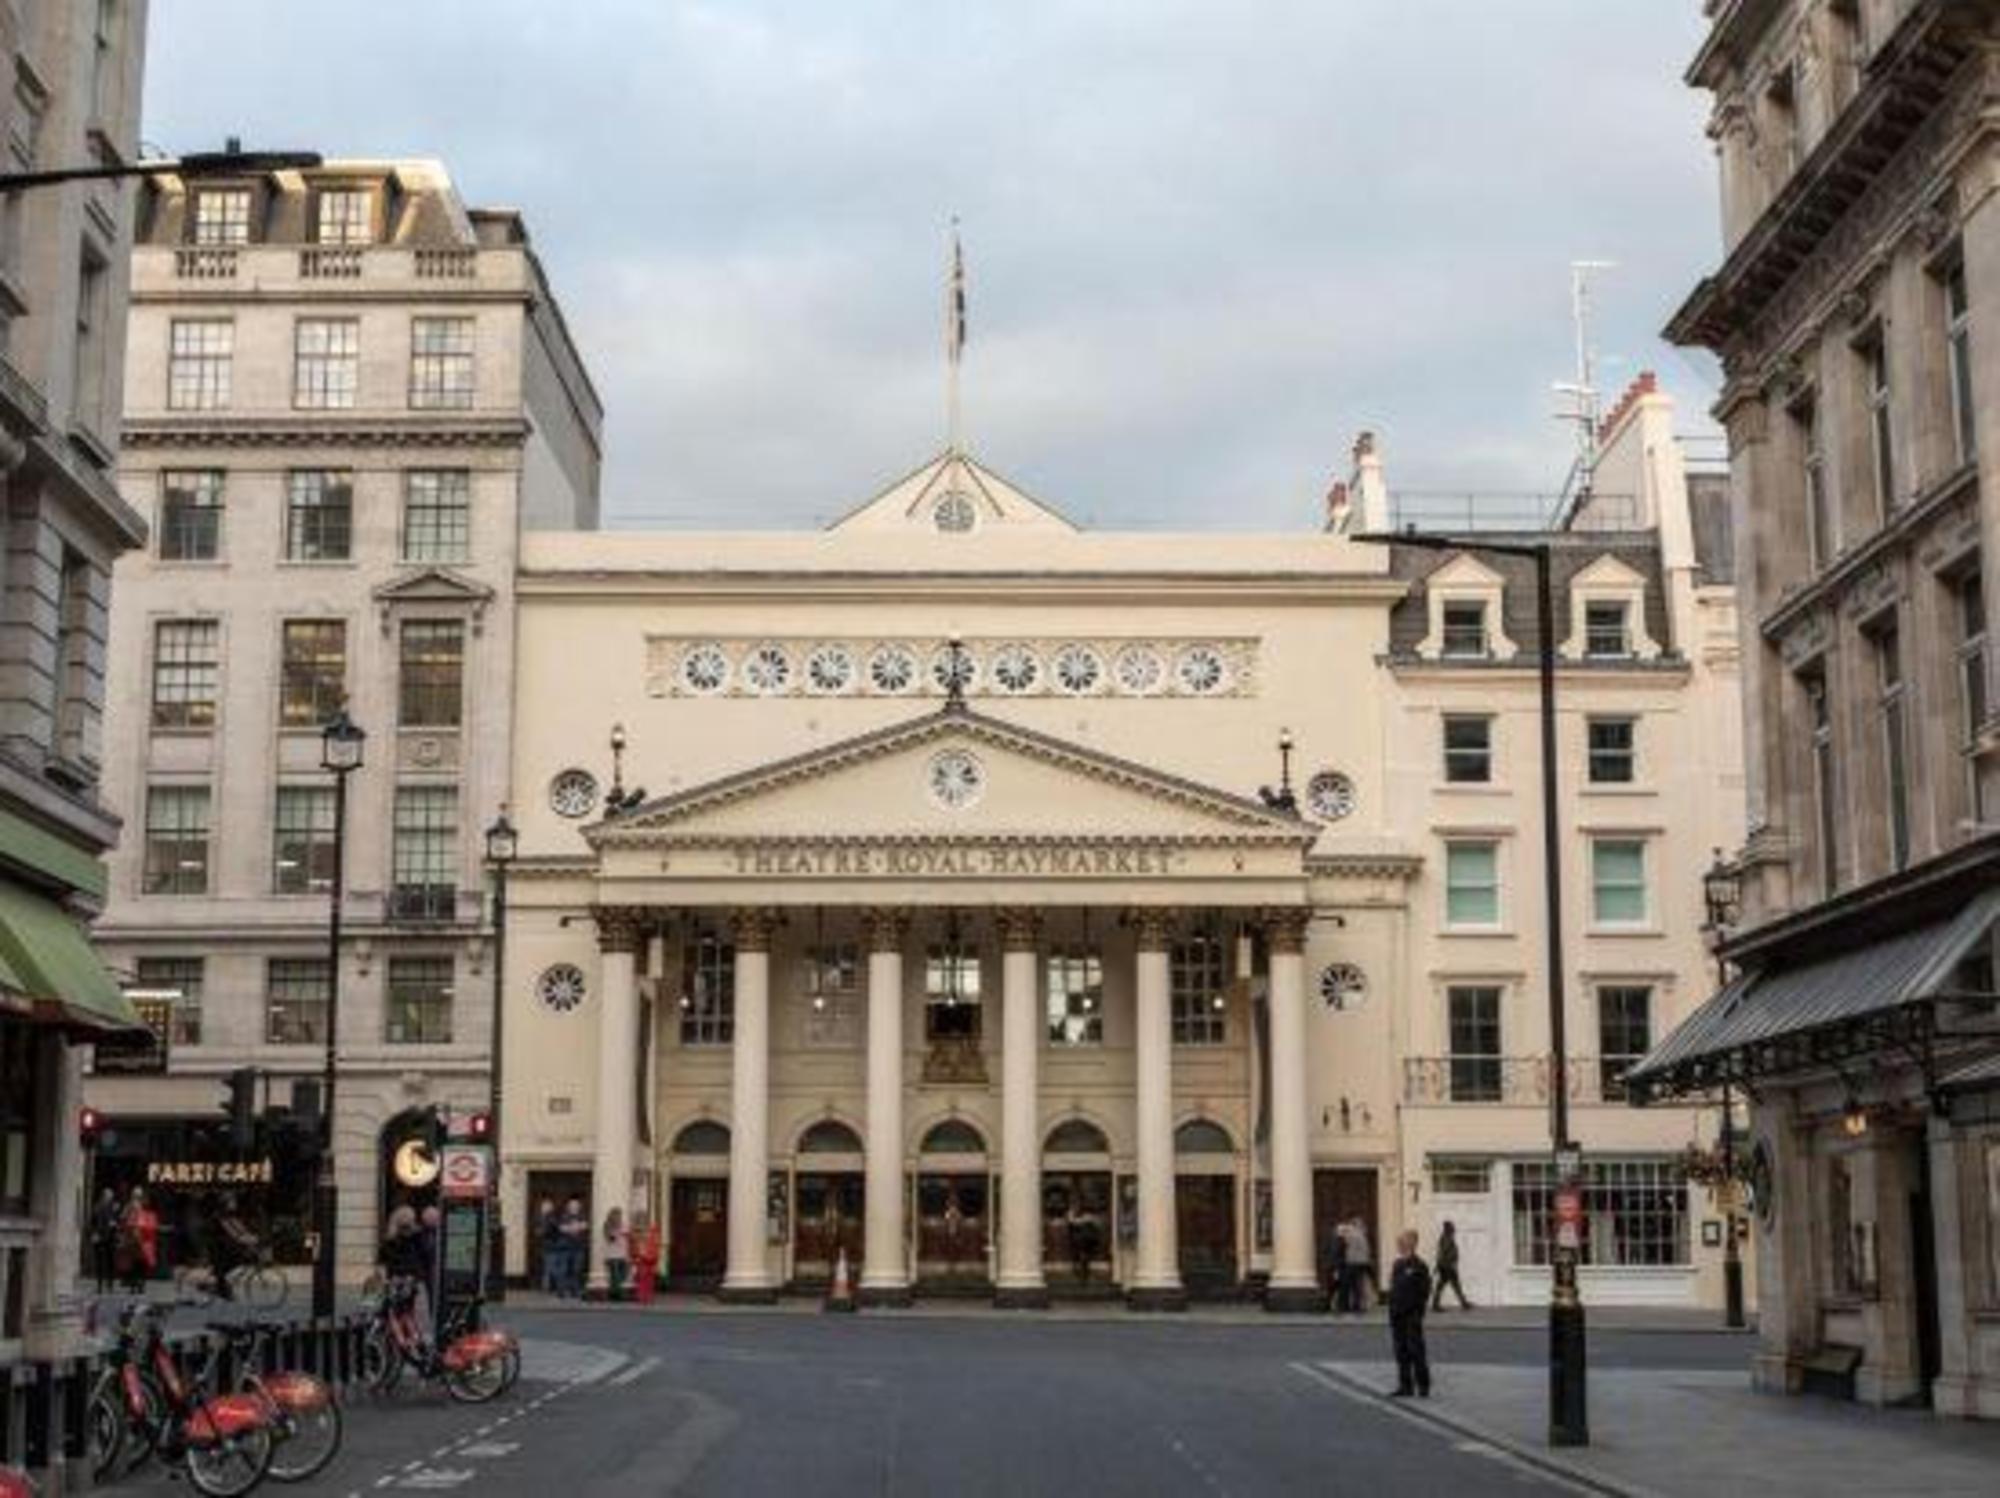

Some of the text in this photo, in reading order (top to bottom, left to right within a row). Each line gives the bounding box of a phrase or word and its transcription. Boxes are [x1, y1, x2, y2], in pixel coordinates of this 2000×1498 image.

[734, 849, 1174, 874] THEATRE ROYAL HAYMARKET
